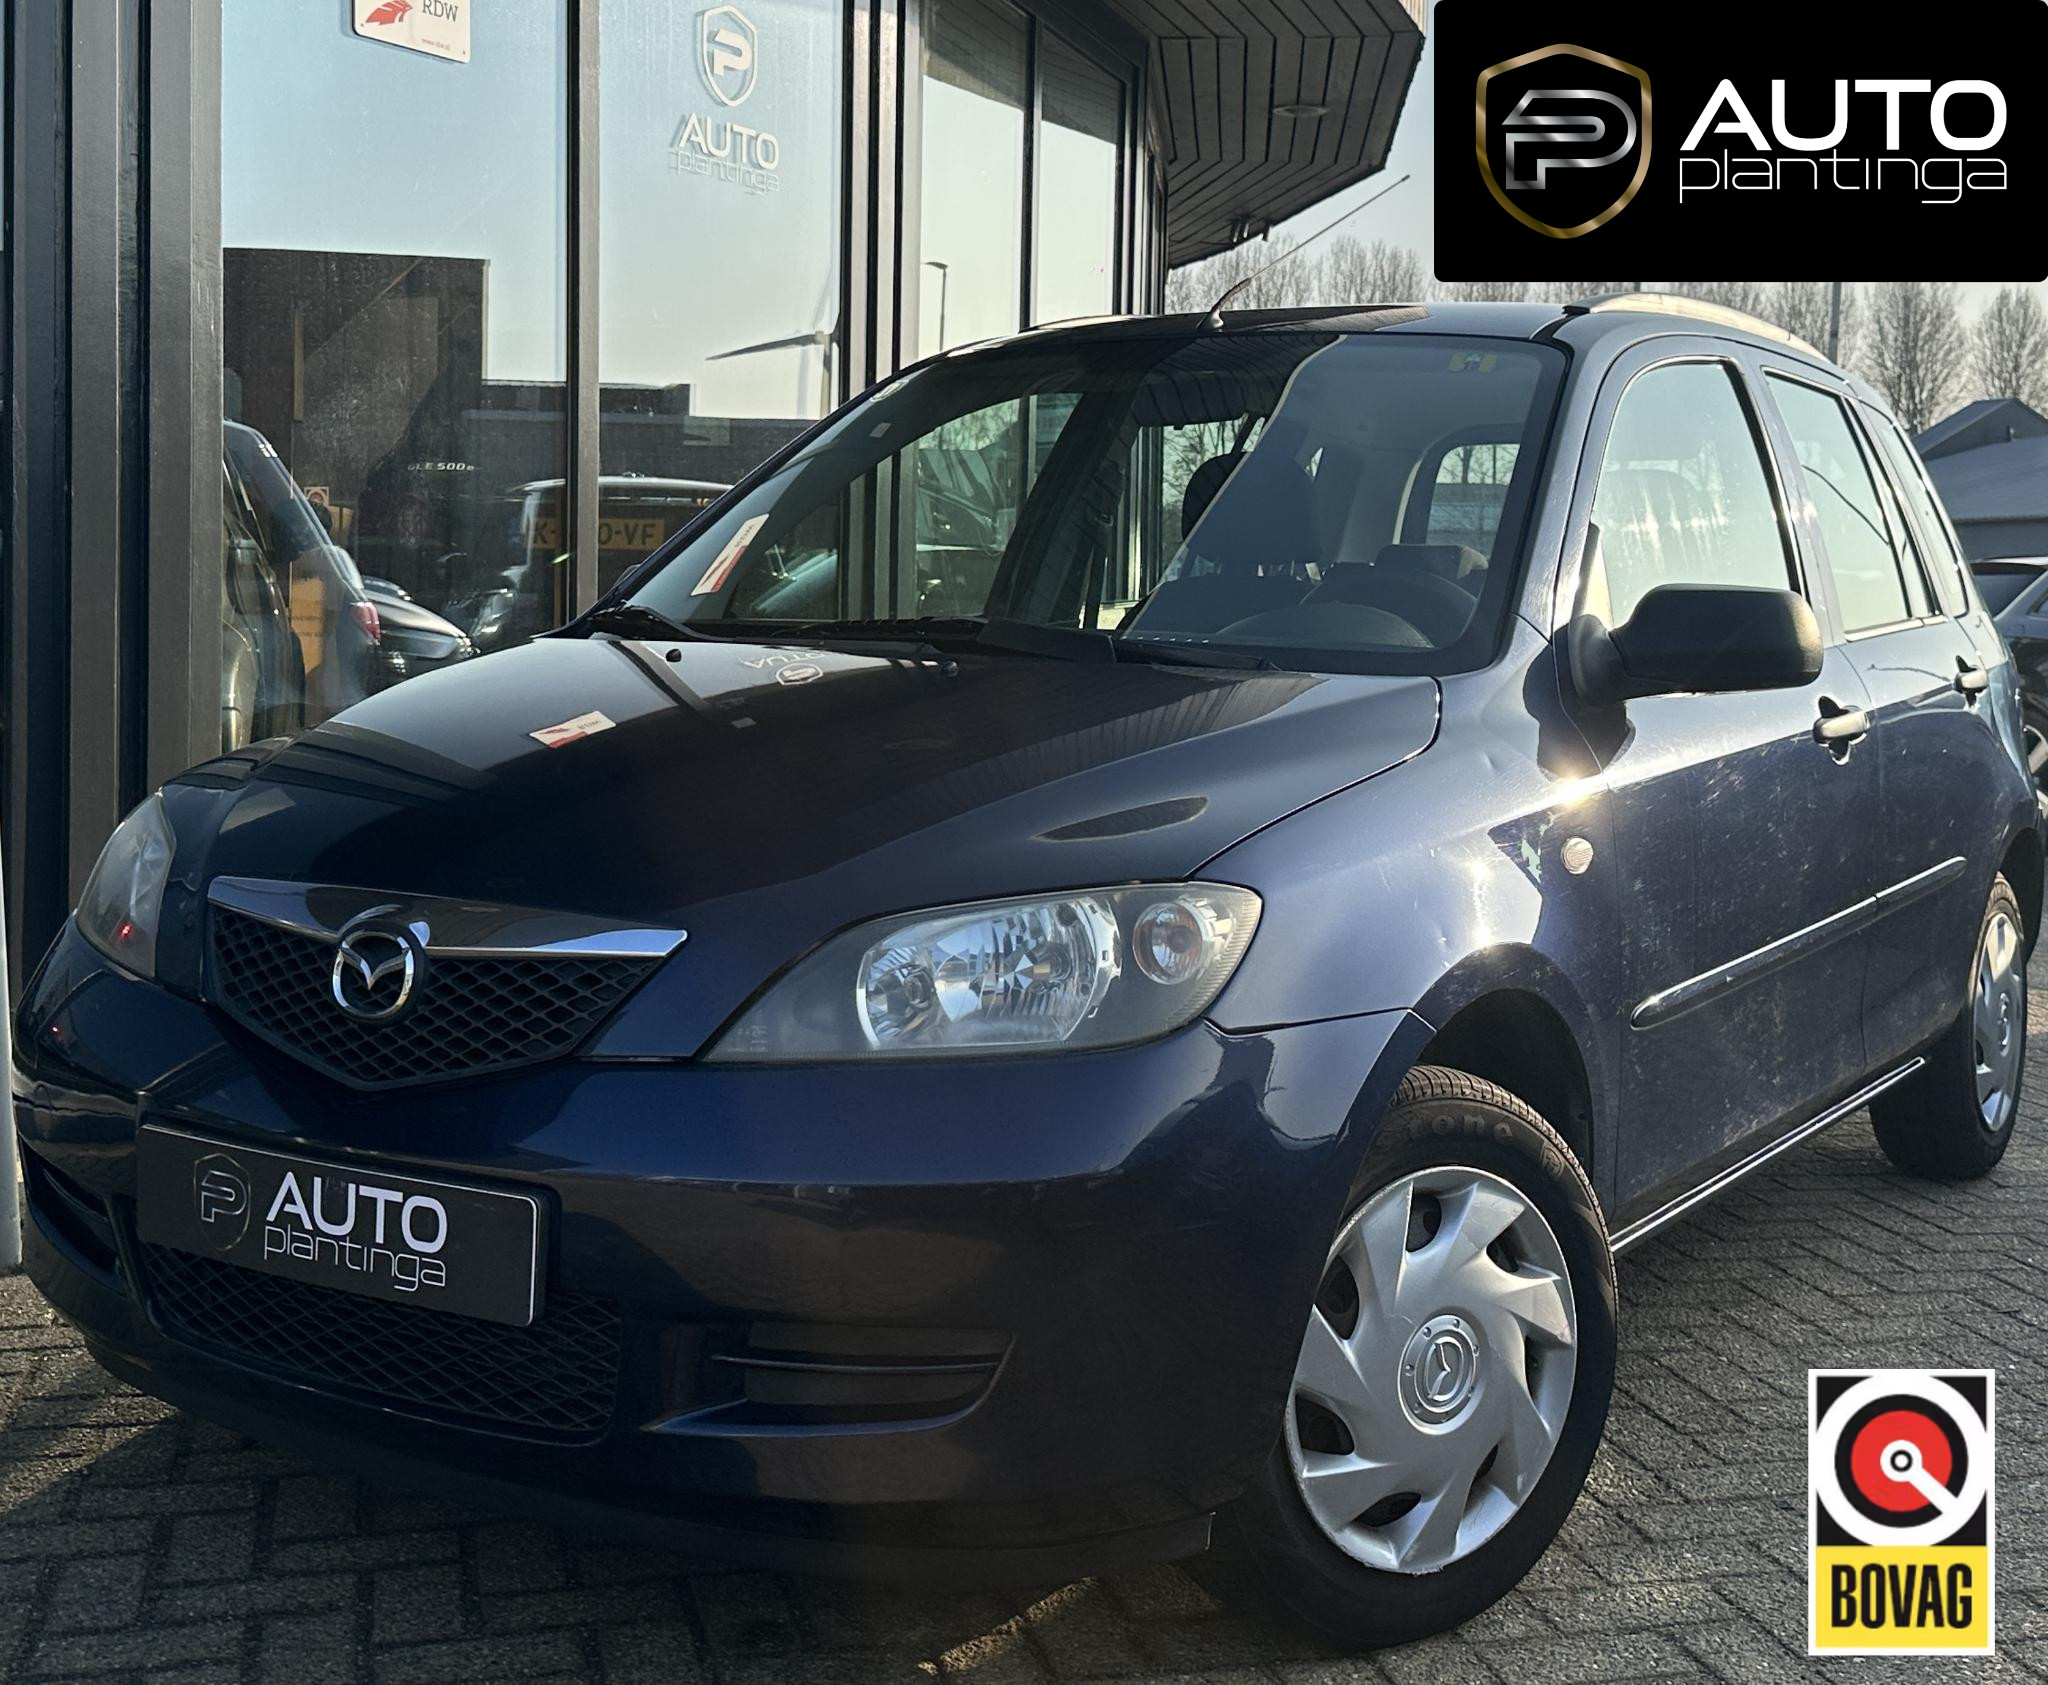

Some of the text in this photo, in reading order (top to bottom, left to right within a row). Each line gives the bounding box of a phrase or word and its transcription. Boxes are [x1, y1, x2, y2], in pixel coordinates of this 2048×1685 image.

[422, 0, 459, 22] RDW
[678, 112, 780, 170] AUTO
[265, 1171, 448, 1254] AUTO
[264, 1222, 446, 1292] plantinga
